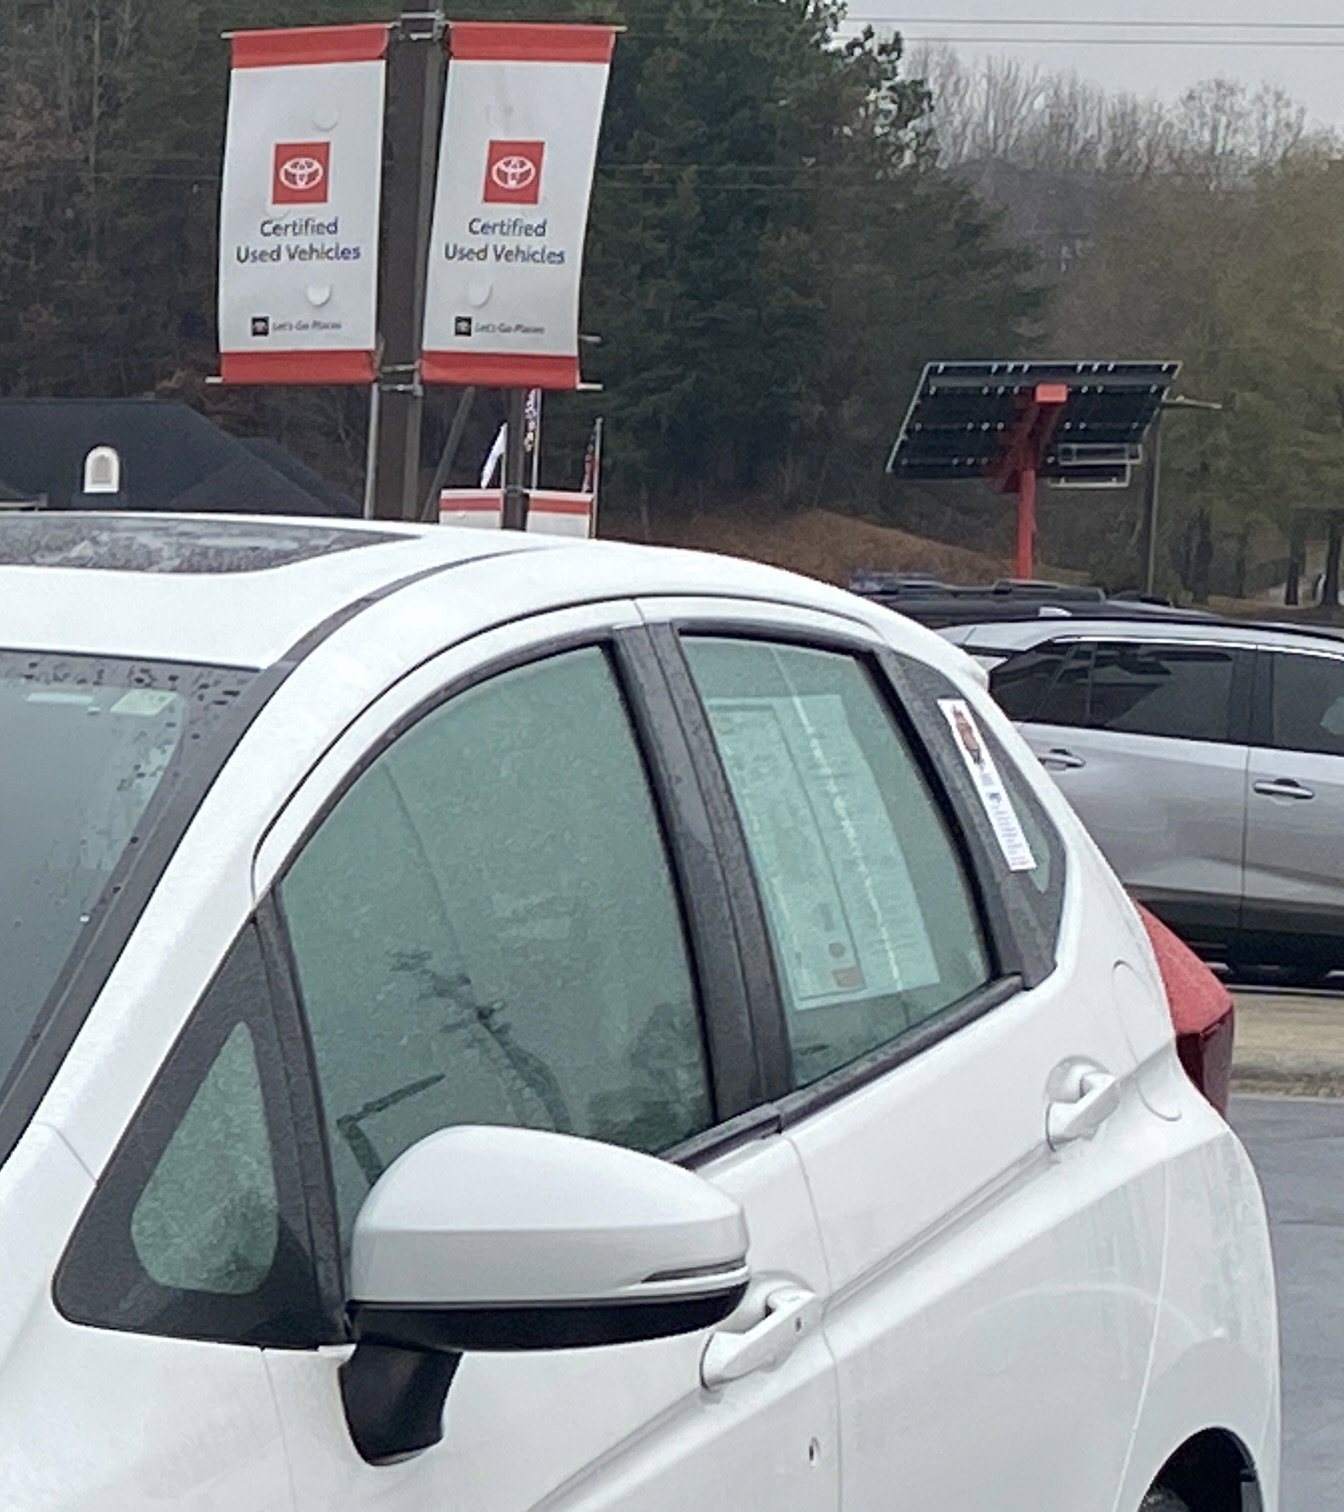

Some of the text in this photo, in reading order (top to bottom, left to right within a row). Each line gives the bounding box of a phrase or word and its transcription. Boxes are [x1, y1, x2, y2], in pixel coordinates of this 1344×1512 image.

[260, 216, 339, 237] Certified
[468, 217, 548, 237] Certified
[236, 242, 362, 263] Used Vehicles
[444, 242, 566, 265] Used Vehicles
